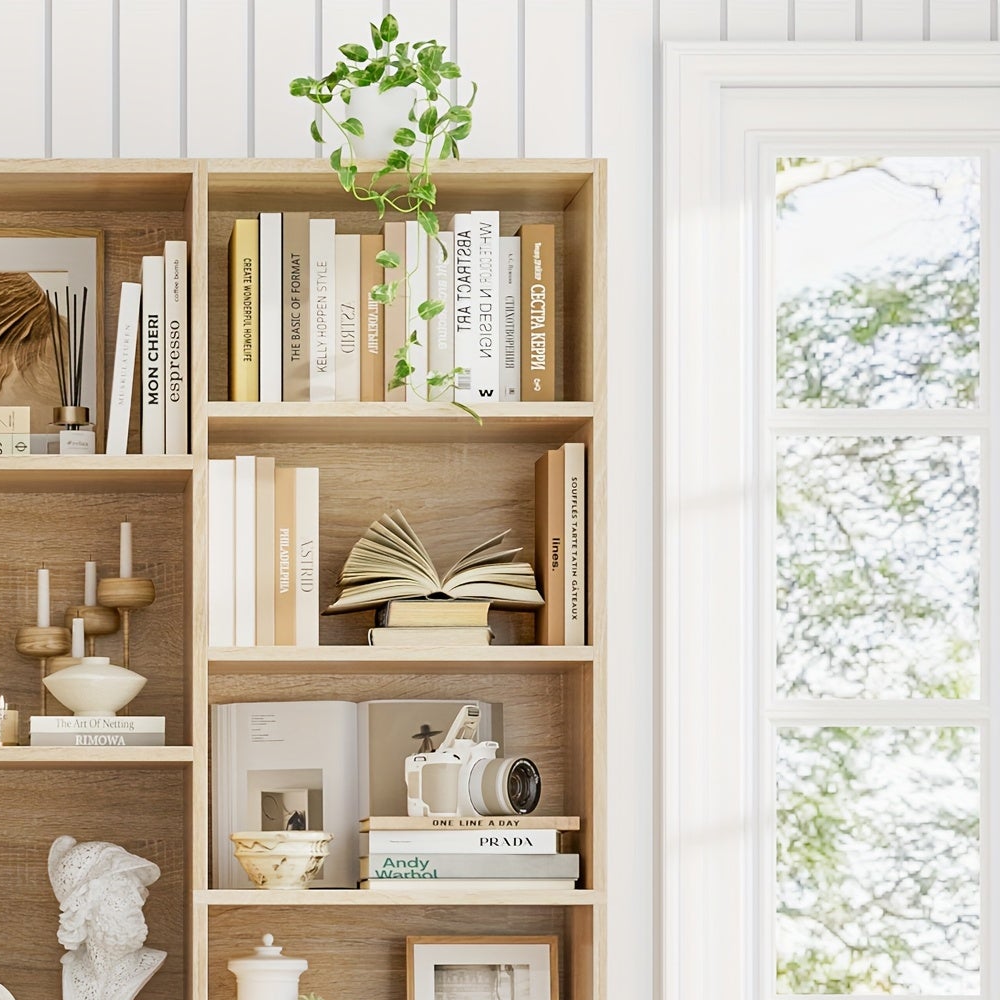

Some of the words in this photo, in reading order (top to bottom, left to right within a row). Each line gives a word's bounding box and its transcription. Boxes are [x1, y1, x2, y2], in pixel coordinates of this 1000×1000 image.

[243, 258, 252, 283] CREATE
[290, 253, 301, 294] FORMAT
[316, 261, 328, 294] STYLE
[243, 285, 252, 326] WONDERFUL
[290, 297, 301, 310] OF
[316, 296, 328, 338] HOPPEN
[531, 284, 546, 330] СЕСТРА
[148, 314, 158, 361] CHERI
[290, 313, 301, 340] BASIC
[505, 295, 515, 369] СТИХОТВОРЕНИЯ
[170, 321, 183, 402] espresso
[243, 328, 252, 362] HOMELIFE
[290, 343, 301, 362] THE
[316, 340, 328, 373] KELLY
[530, 332, 546, 370] КЕРРИ
[148, 367, 158, 405] MON
[280, 528, 289, 593] PHILADELPHIA
[552, 538, 560, 571] lines.
[571, 580, 579, 620] GÂTEAUX
[56, 719, 74, 728] The
[76, 719, 87, 728] Art
[89, 719, 101, 728] Of
[103, 719, 134, 730] Netting
[75, 736, 126, 746] RIMOWA
[480, 838, 533, 847] PRADA
[383, 857, 430, 871] Andy
